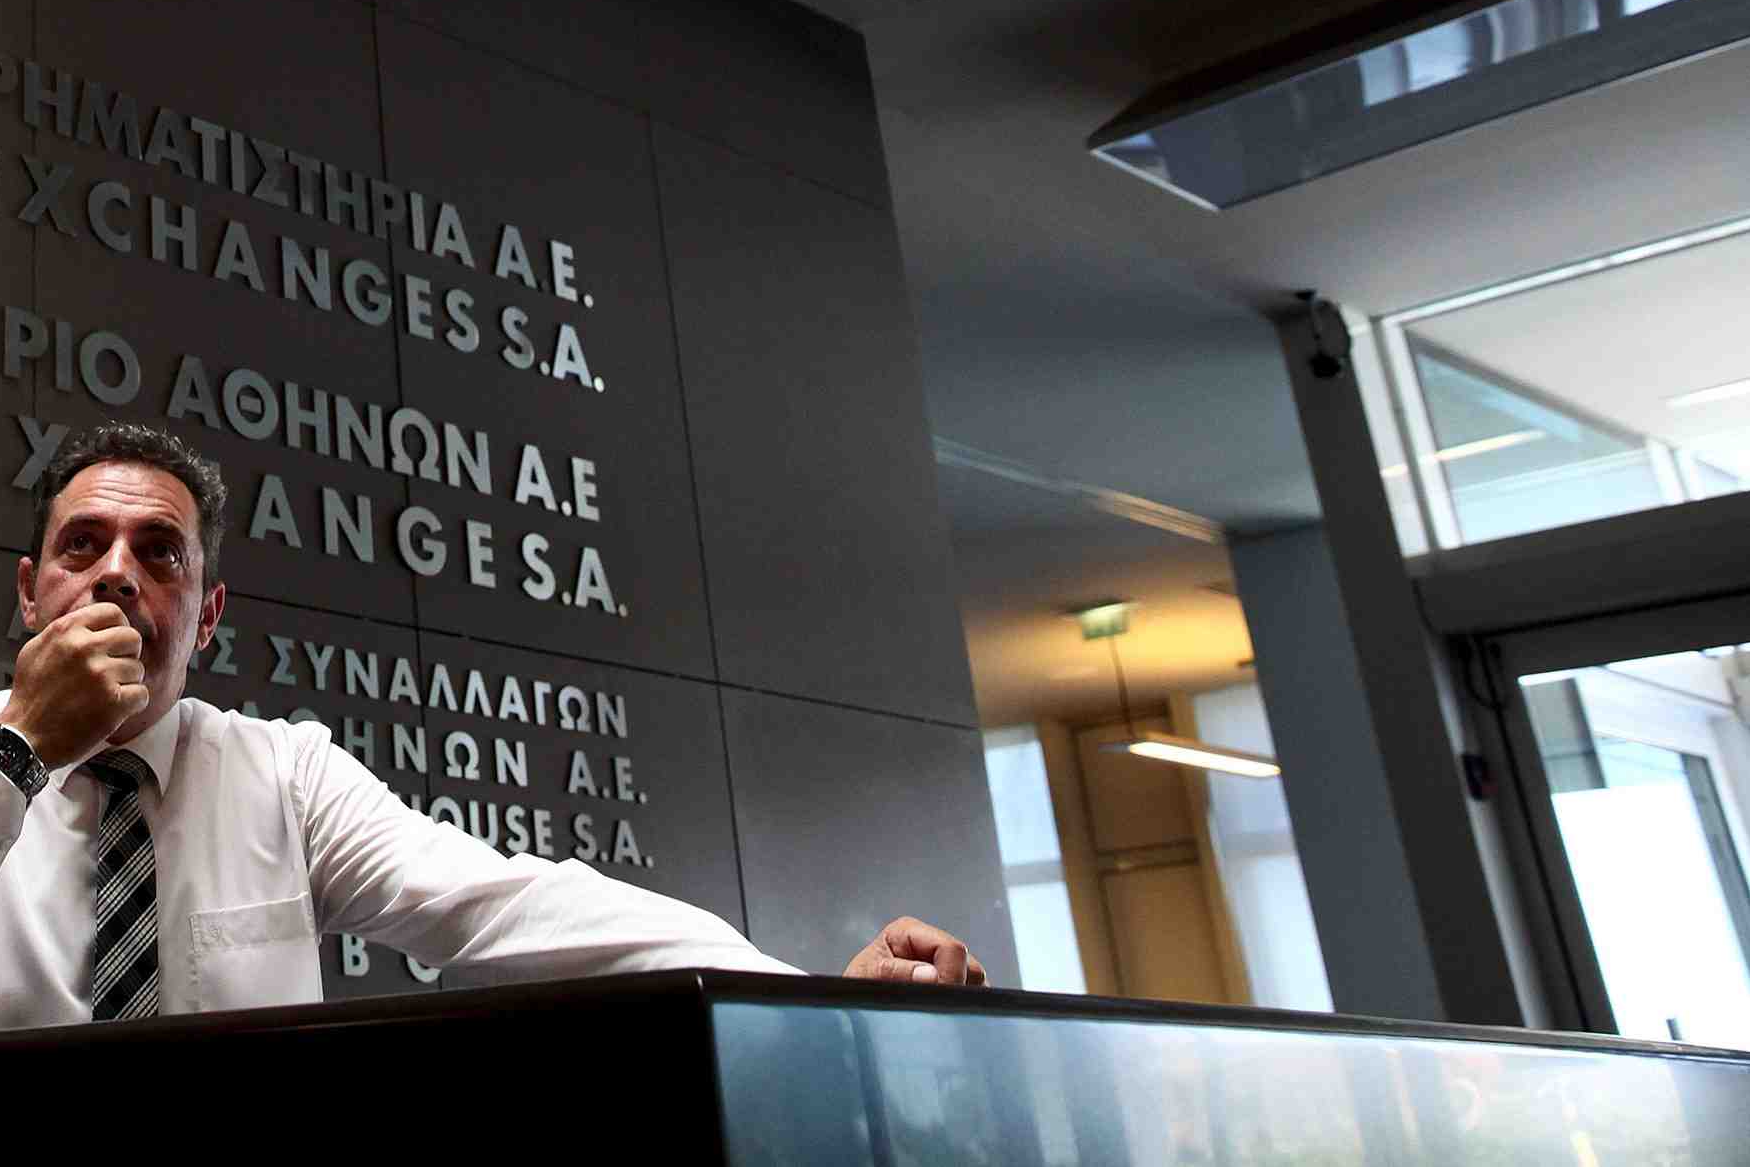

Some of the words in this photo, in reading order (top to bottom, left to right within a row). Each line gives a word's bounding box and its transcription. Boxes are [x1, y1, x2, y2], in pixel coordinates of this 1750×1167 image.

[499, 305, 607, 395] S.A.
[166, 353, 493, 497] ΑΘΗΝΩΝ
[519, 531, 629, 618] S.A.
[264, 634, 629, 739] ΣΥΝΑΛΛΑΓΩΝ
[571, 811, 655, 868] S.A.
